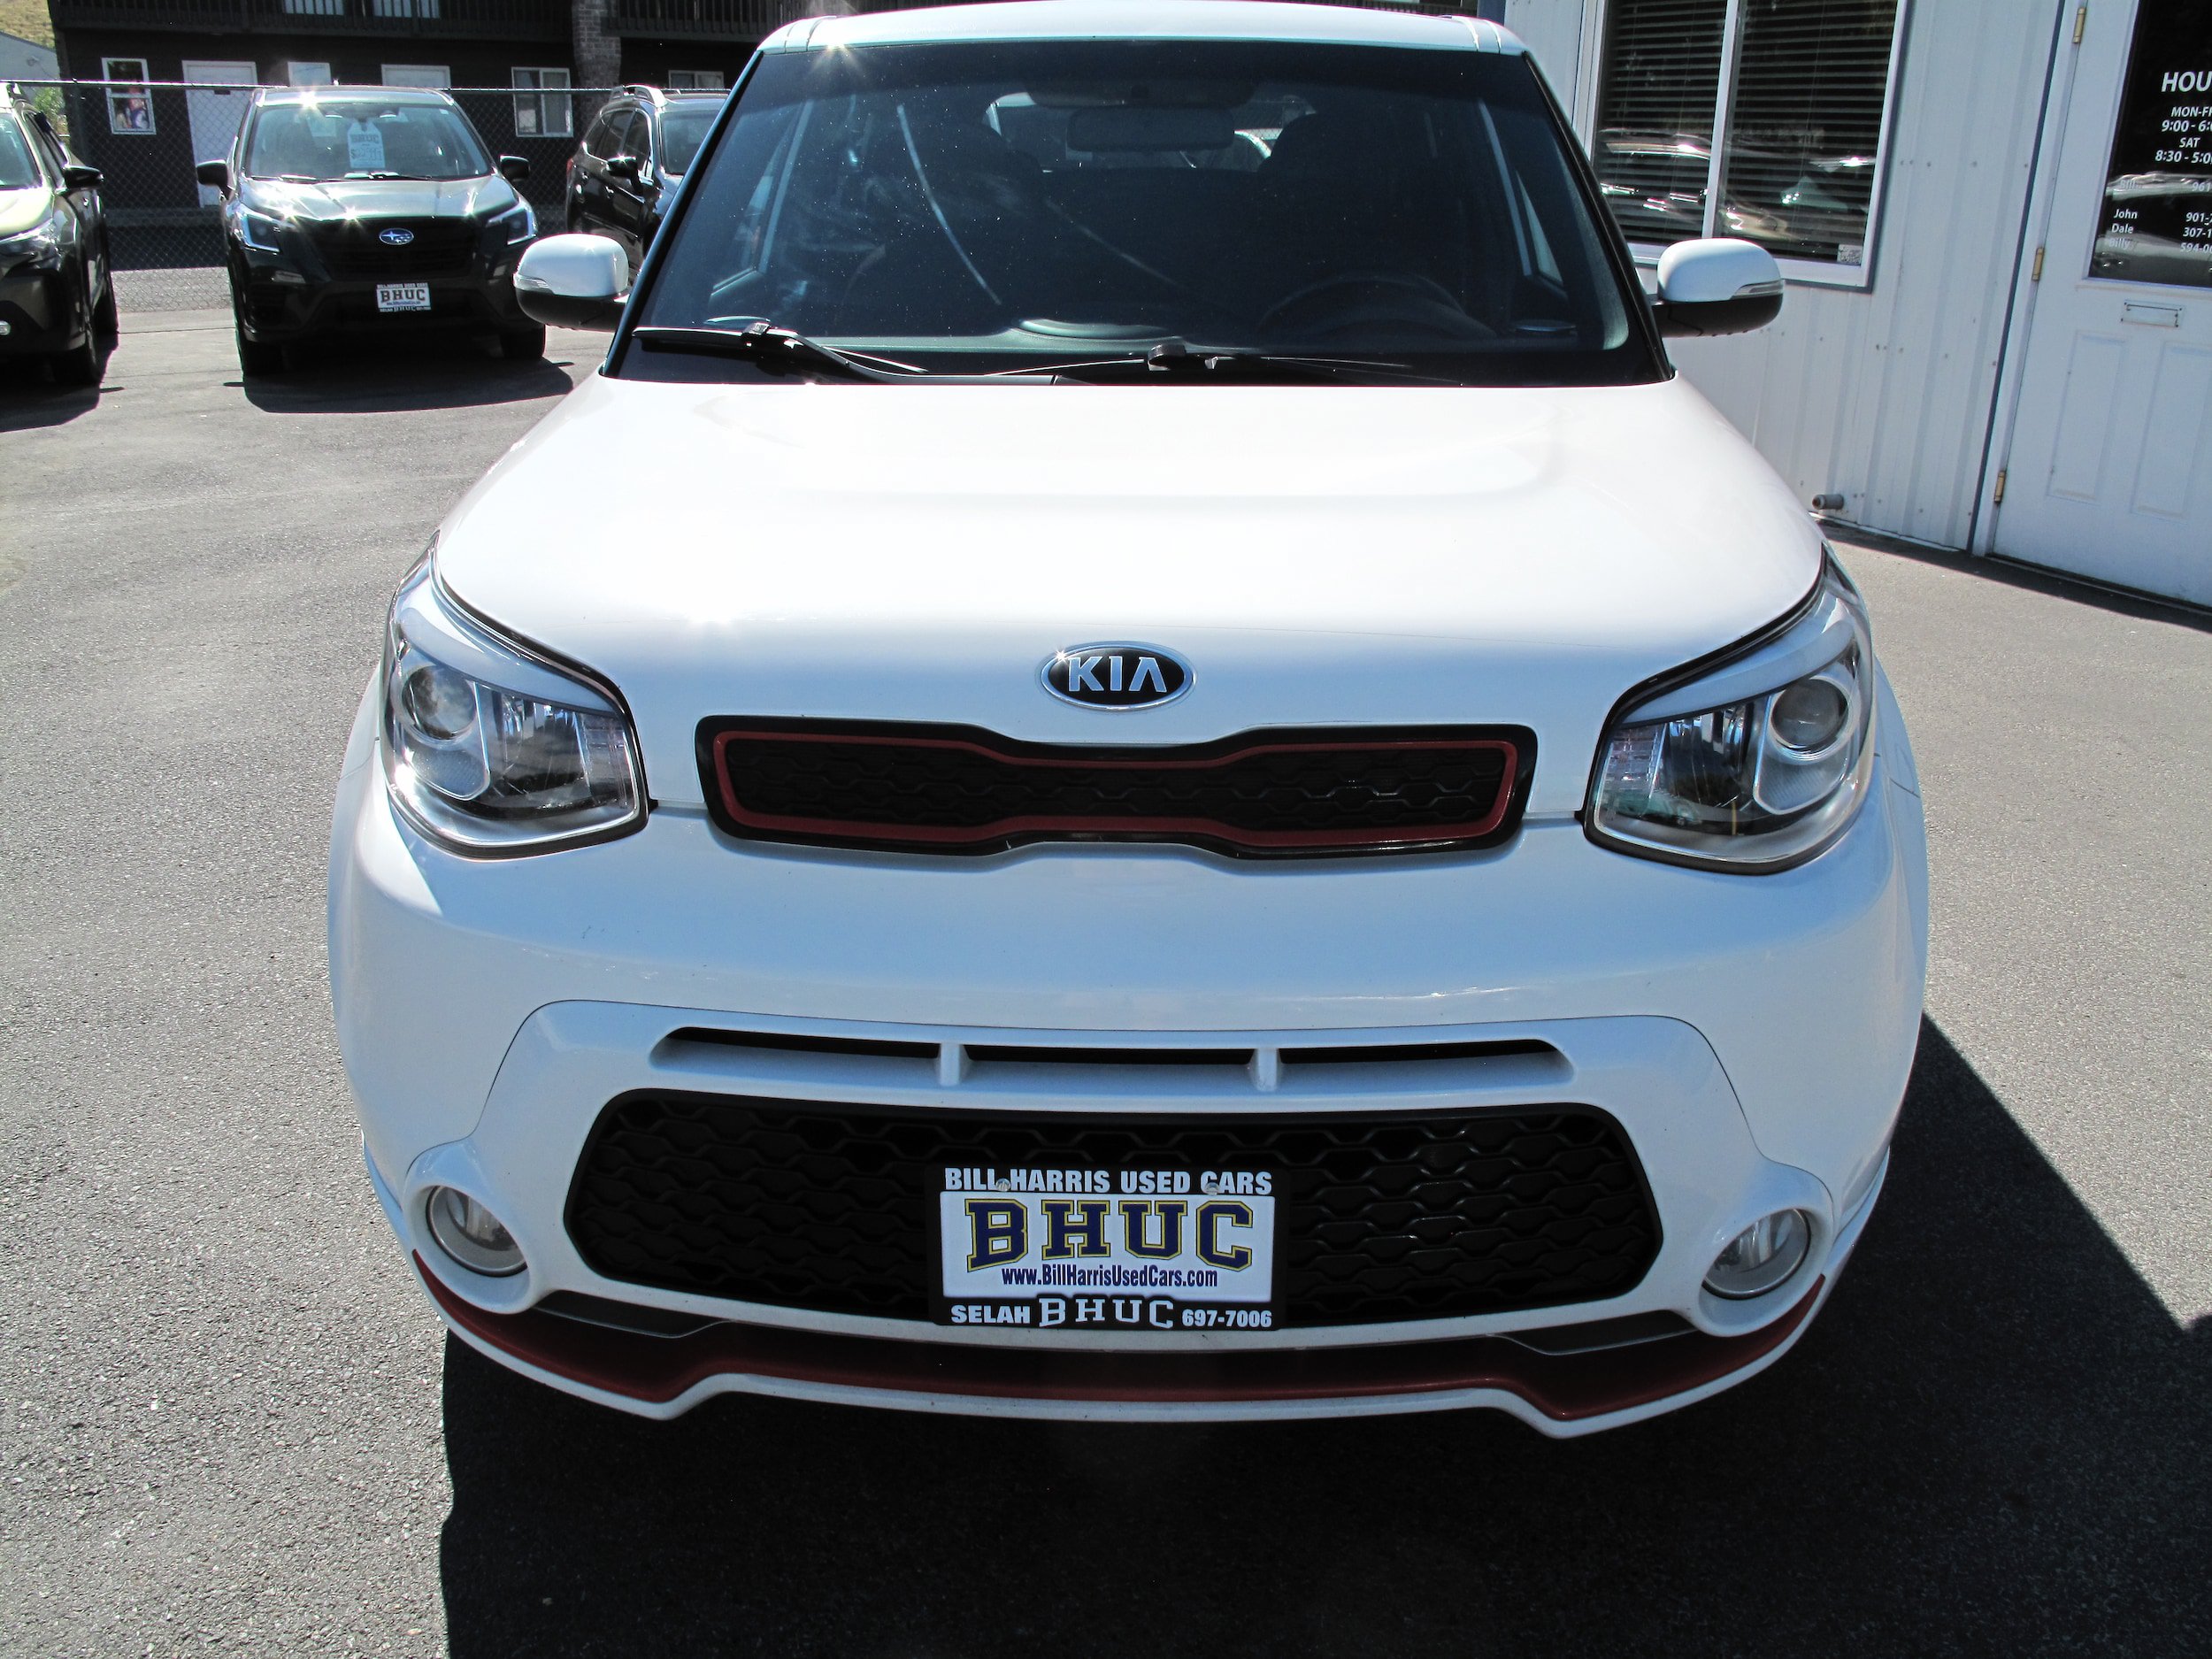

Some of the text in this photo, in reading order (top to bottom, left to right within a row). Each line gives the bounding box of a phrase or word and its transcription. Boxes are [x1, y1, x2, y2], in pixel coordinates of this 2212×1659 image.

[2161, 119, 2190, 133] 9:00
[2198, 119, 2212, 133] 6:
[2178, 137, 2200, 149] SAT
[2154, 150, 2182, 163] 8:30
[2191, 151, 2212, 165] 5:0
[2113, 209, 2138, 219] John
[2111, 223, 2134, 234] Dale
[2109, 238, 2131, 250] Billy
[380, 288, 426, 303] BHUC
[1067, 656, 1168, 693] KIA
[944, 1167, 1272, 1195] BILL HARRIS USED CARS
[964, 1198, 1253, 1272] BHUC
[1001, 1263, 1218, 1287] www.BillHarrisUsedCars.com
[950, 1297, 1272, 1328] SELAH BHUC 697-7006
